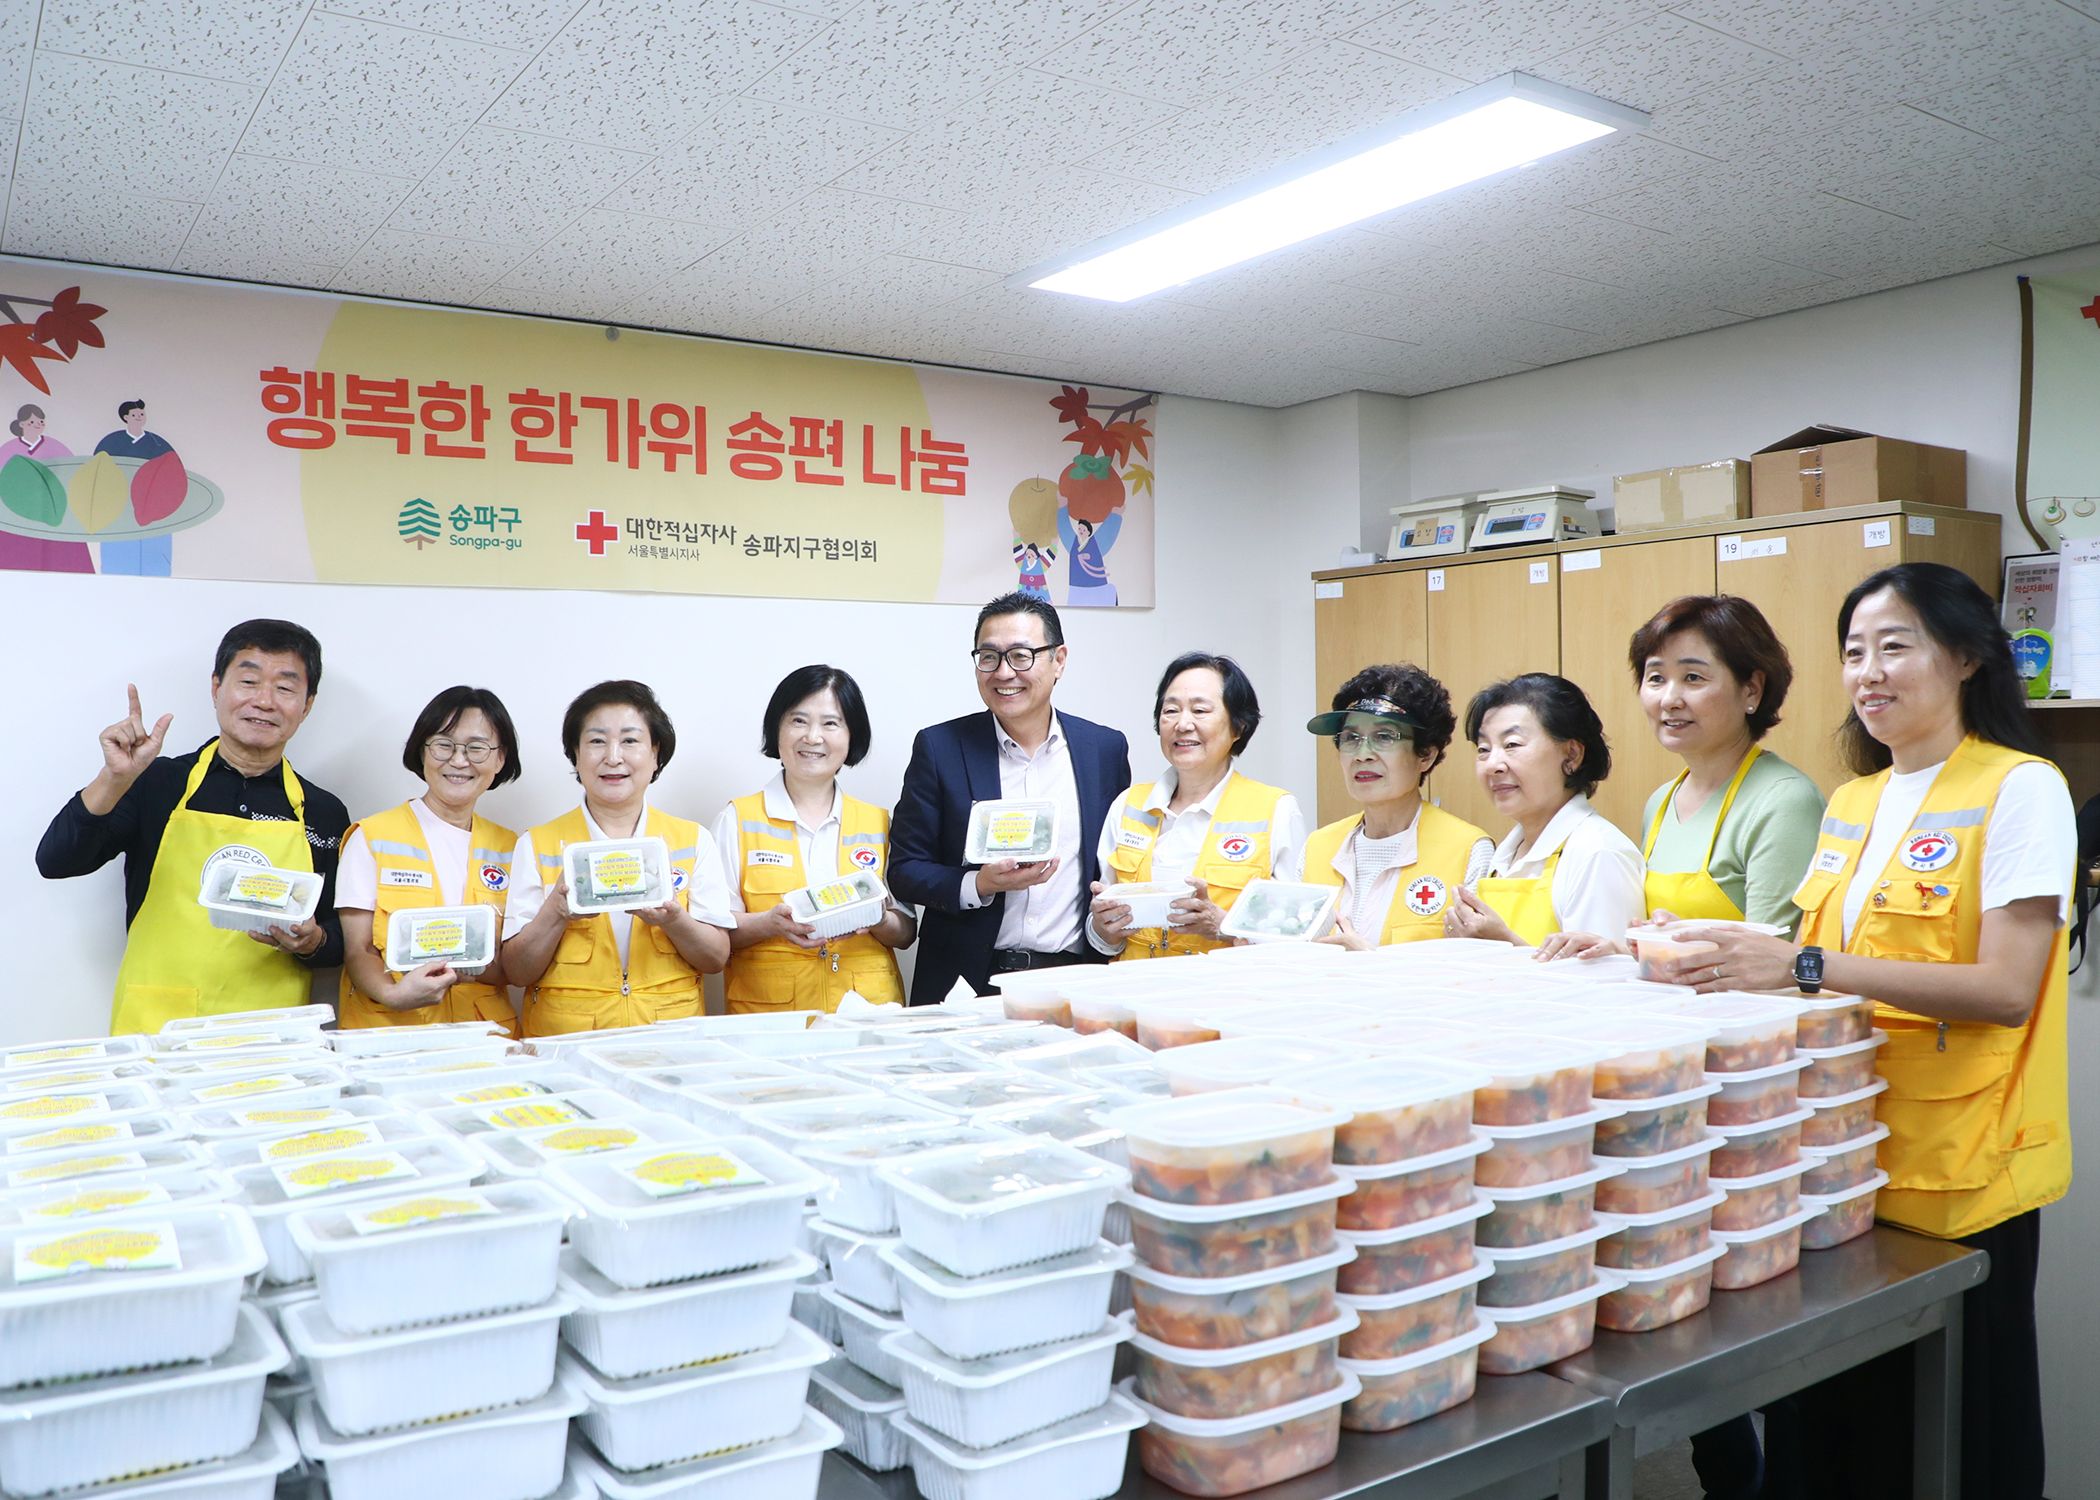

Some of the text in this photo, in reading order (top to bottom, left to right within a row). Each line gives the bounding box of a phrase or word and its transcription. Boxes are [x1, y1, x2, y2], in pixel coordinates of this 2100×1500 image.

[261, 366, 969, 496] 행복한 한가위 송편 나눔
[448, 504, 522, 533] 송파구
[626, 517, 738, 546] 대한적십자사
[1868, 530, 1886, 540] 개방
[449, 534, 522, 551] Songpa-gu
[742, 534, 877, 562] 송파지구협의회
[1724, 543, 1738, 554] 19
[628, 544, 700, 561] 서울특별시지사
[1432, 575, 1442, 585] 17
[2014, 583, 2054, 594] 적십자회비
[233, 849, 251, 859] RED
